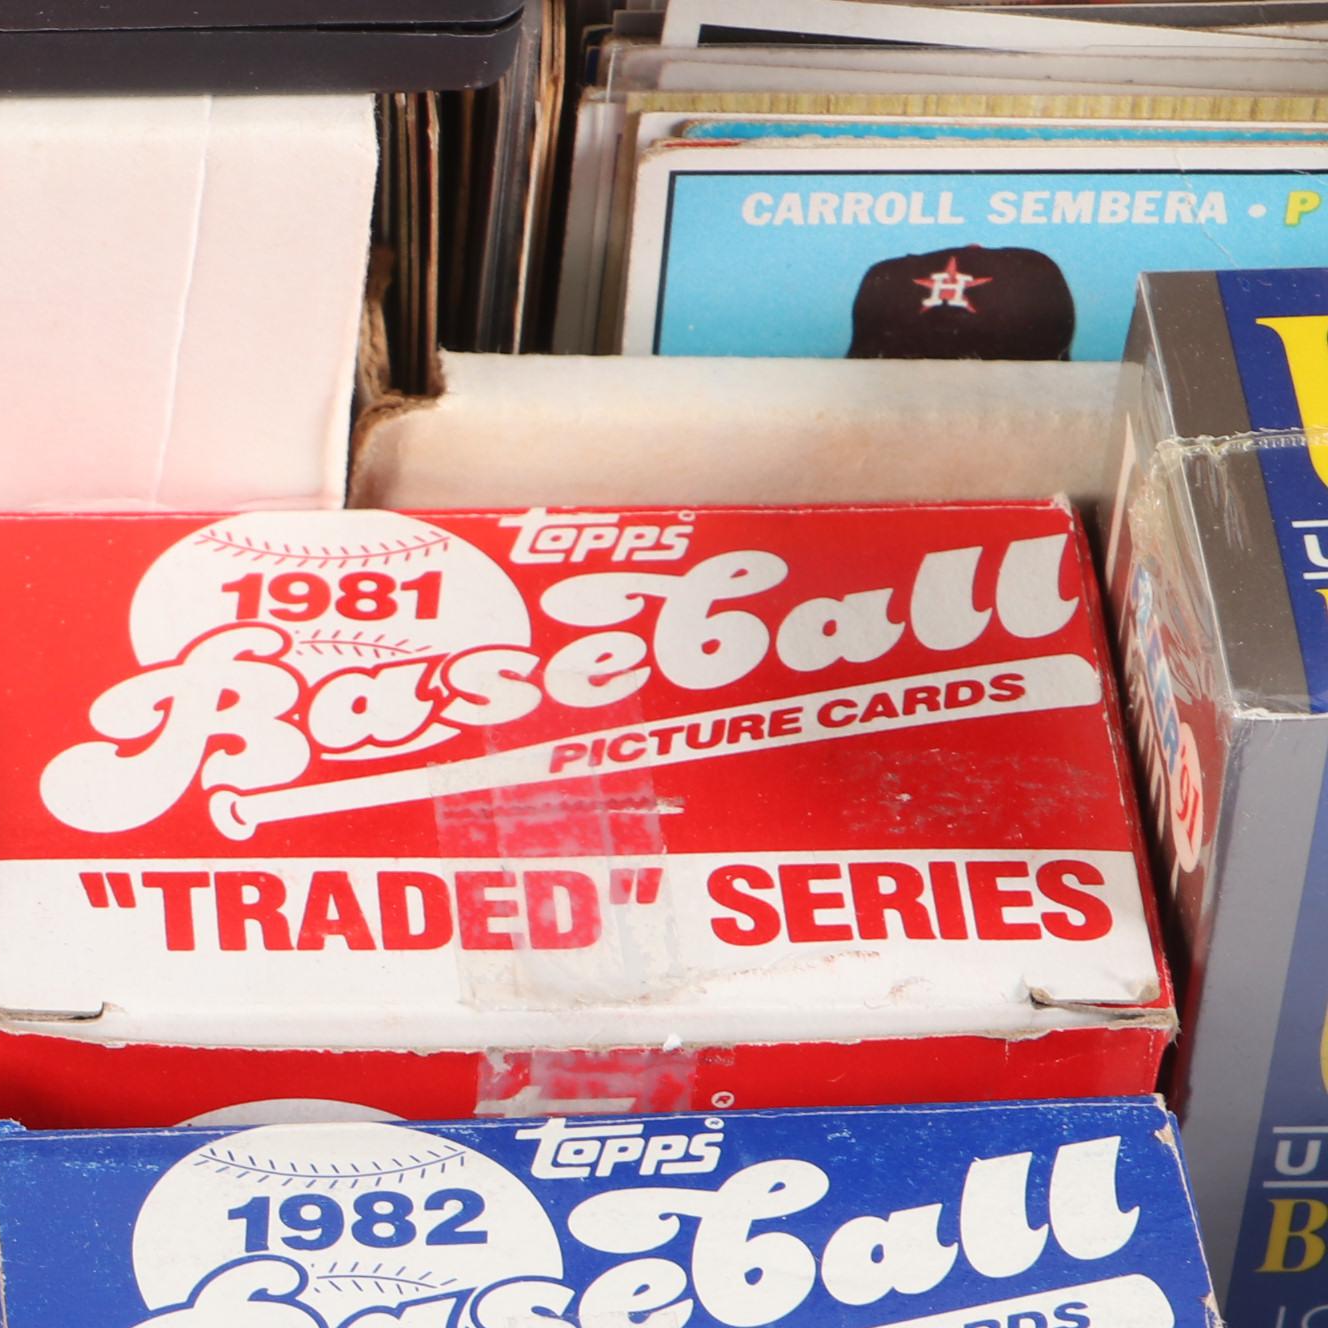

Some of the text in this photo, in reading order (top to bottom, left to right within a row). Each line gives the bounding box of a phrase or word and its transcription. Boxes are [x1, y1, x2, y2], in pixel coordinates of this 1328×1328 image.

[742, 190, 1320, 228] CARROLL SEMBERA P
[222, 571, 442, 622] 1981
[40, 534, 1080, 834] Baseball
[548, 673, 1026, 775] PICTURE CARDS
[79, 858, 1114, 952] "TRADED" SERIES
[227, 1191, 490, 1253] 1982
